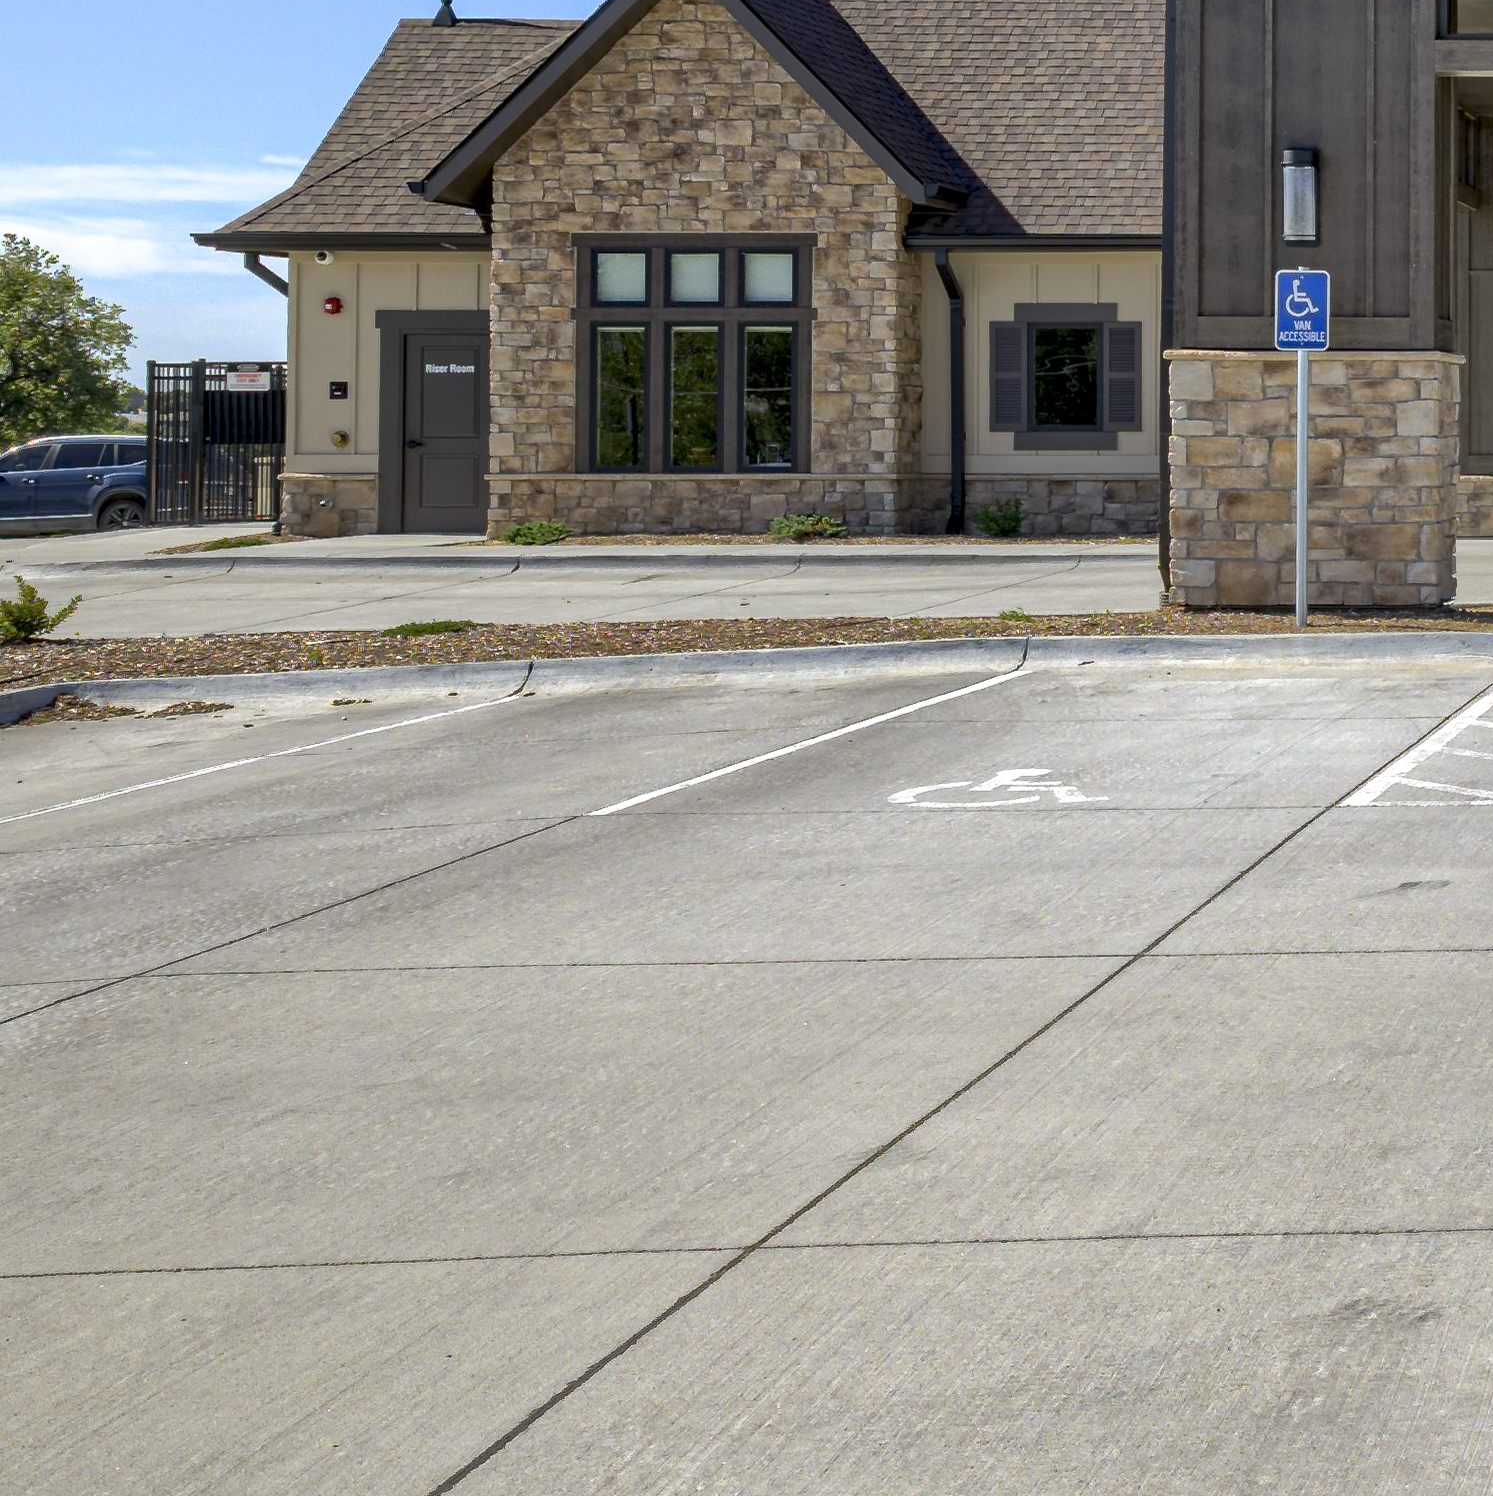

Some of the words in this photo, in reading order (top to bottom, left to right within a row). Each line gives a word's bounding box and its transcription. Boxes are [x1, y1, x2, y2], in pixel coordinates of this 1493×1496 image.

[1293, 320, 1312, 330] VAN
[1279, 331, 1326, 342] ACCESSIBLE
[425, 363, 448, 373] Riser
[449, 363, 475, 373] Room
